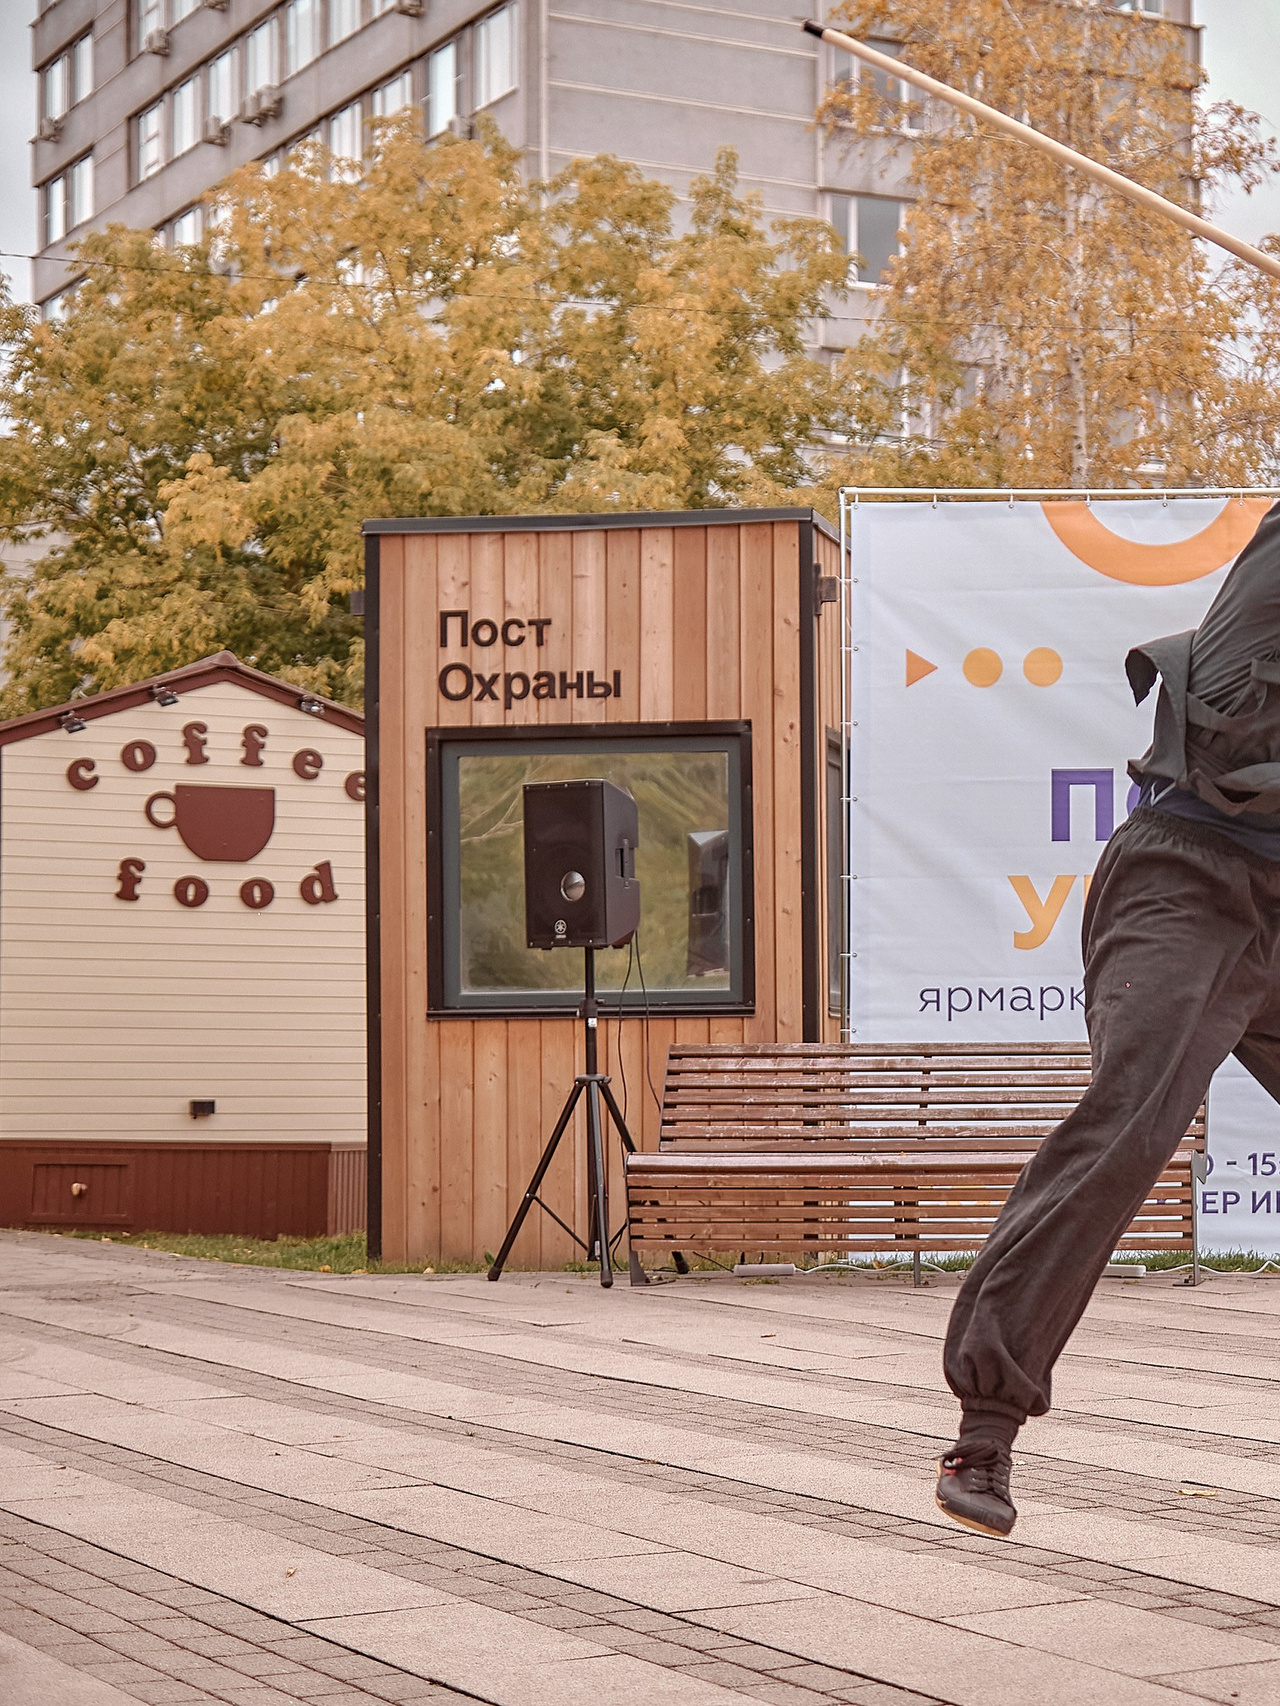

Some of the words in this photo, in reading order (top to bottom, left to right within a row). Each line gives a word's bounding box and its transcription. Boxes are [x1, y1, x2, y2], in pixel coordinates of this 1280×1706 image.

[440, 610, 552, 647] Пост
[438, 662, 621, 709] Охраны
[67, 721, 365, 801] coffee
[115, 857, 338, 908] food
[919, 986, 1085, 1021] ярмарк
